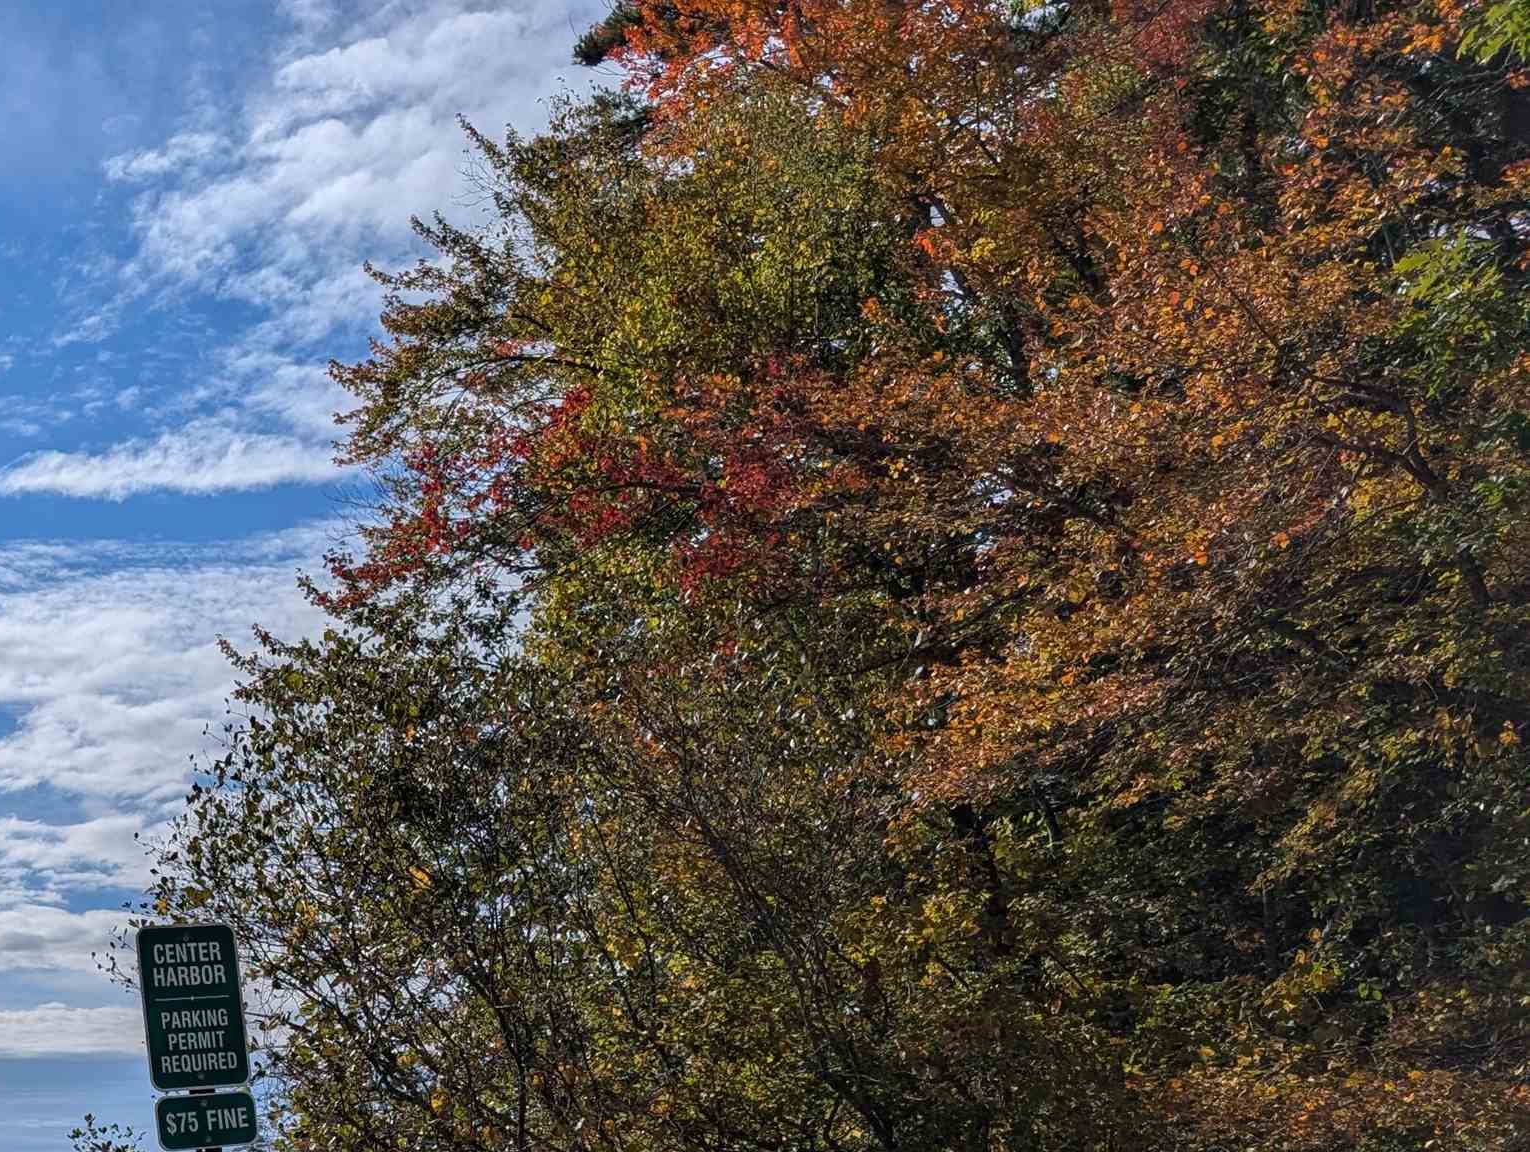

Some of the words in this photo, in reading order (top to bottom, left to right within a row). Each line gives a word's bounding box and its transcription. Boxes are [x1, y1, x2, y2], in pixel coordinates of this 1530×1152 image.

[153, 942, 222, 965] CENTER
[153, 964, 227, 987] HARBOR
[161, 1008, 229, 1029] PARKING
[168, 1030, 226, 1051] PERMIT
[161, 1051, 238, 1073] REQUIRED
[166, 1111, 199, 1136] $75
[206, 1107, 250, 1131] FINE
